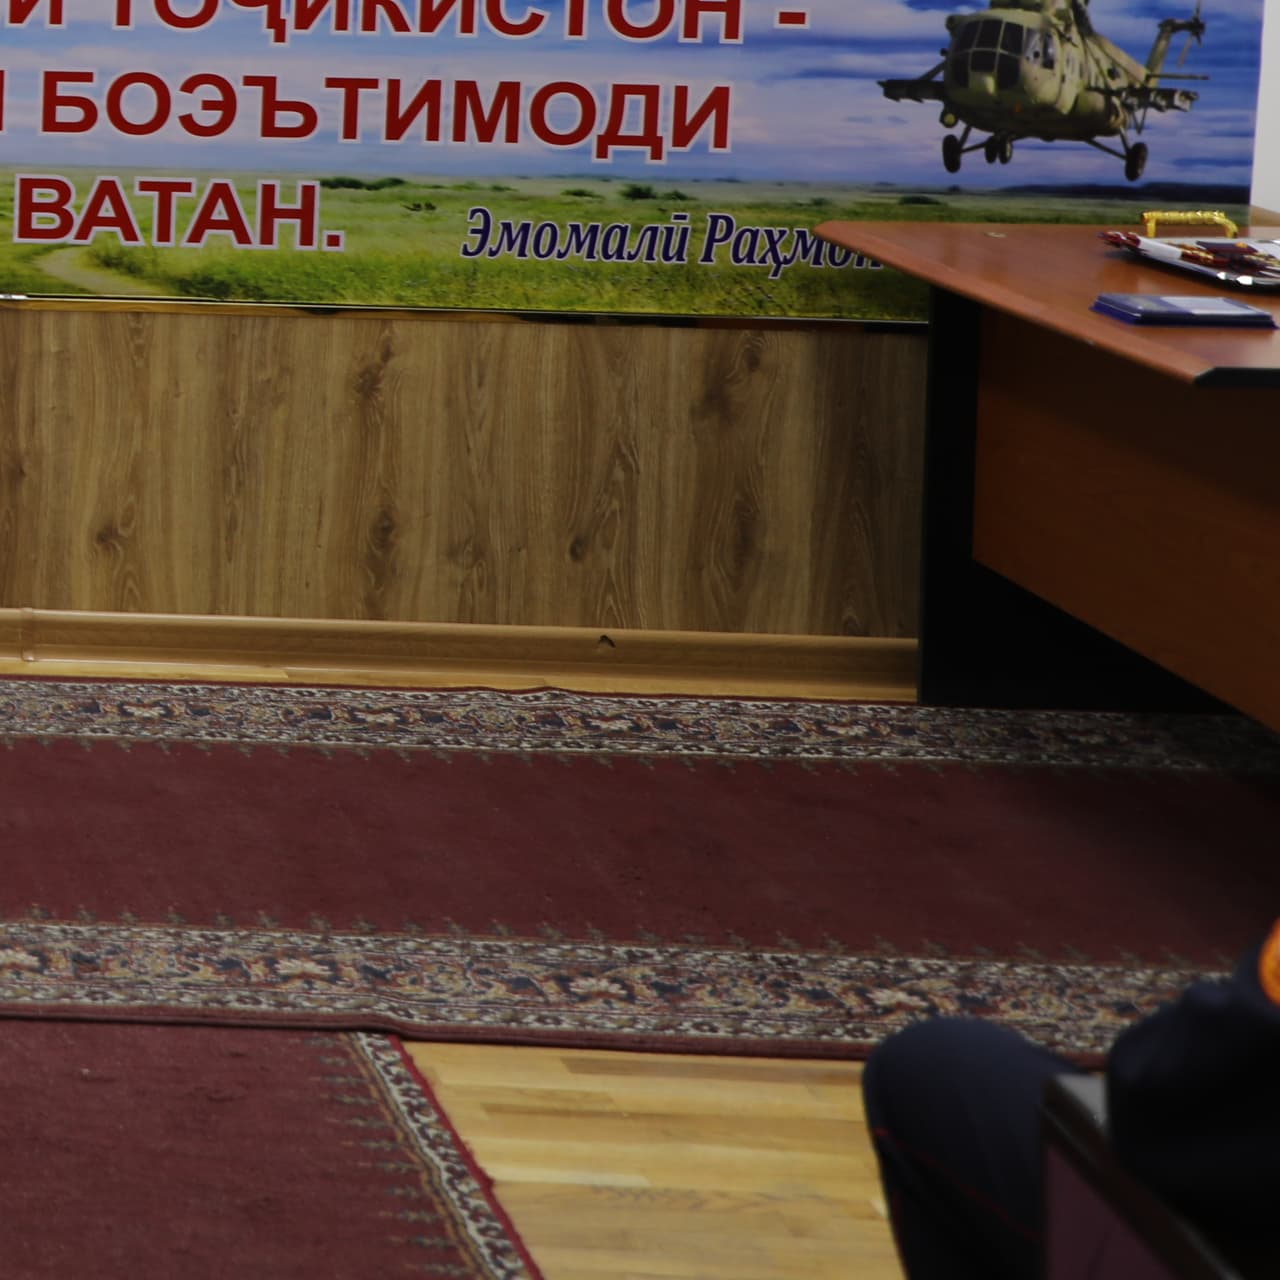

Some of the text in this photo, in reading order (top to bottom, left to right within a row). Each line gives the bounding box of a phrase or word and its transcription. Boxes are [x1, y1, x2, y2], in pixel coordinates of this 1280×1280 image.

[37, 68, 733, 166] БОЭЪТИМОДИ
[12, 173, 347, 252] ВАТАН.
[460, 207, 691, 264] Эмомалӣ
